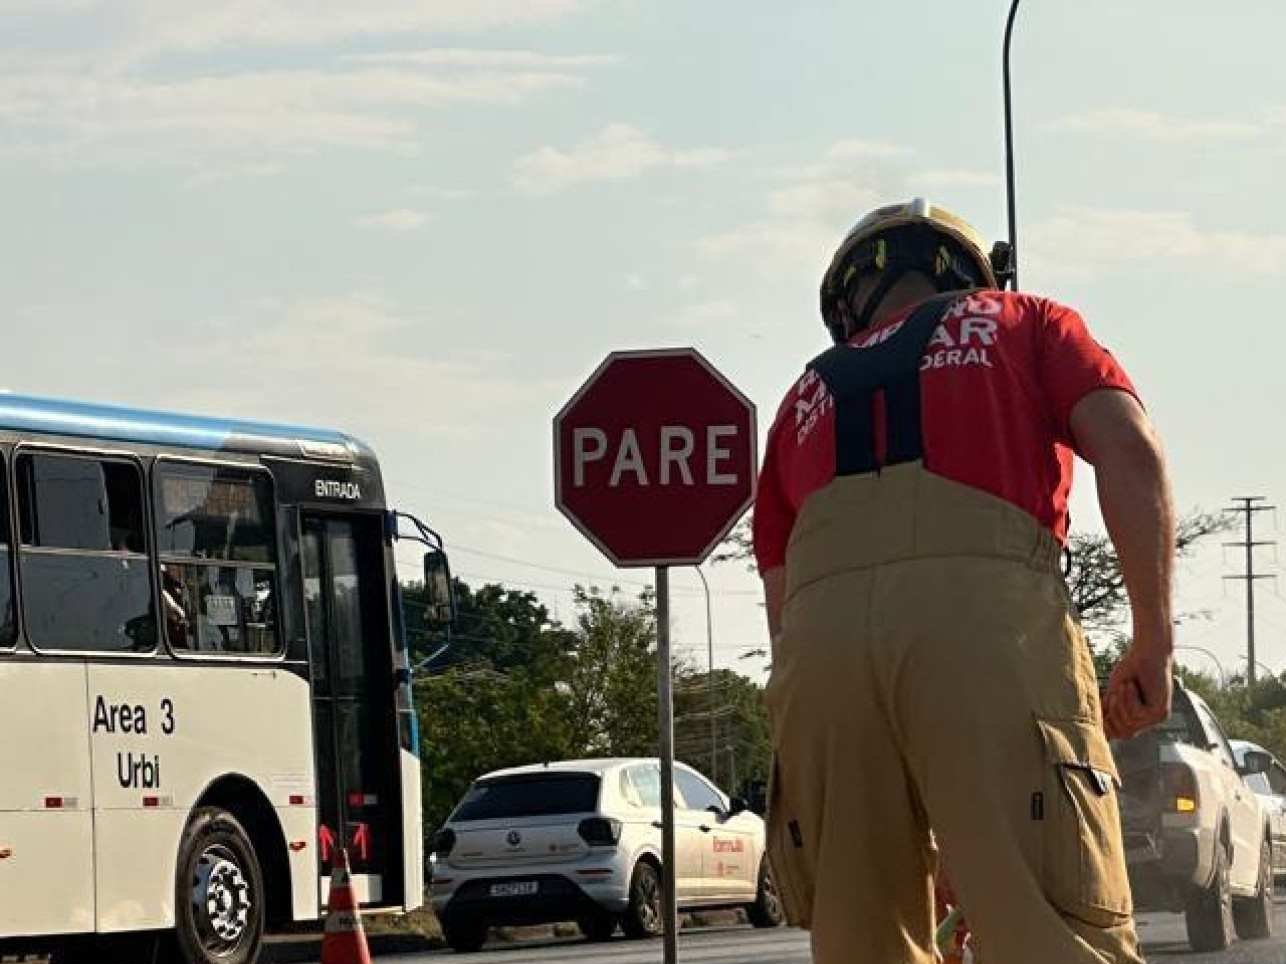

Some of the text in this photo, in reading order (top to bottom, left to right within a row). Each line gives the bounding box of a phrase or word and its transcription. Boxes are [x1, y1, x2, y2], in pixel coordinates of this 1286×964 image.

[920, 348, 994, 370] DERAL
[573, 425, 739, 486] PARE
[315, 479, 361, 499] ENTRADA
[93, 695, 174, 734] Area 3
[117, 752, 159, 788] Urbi
